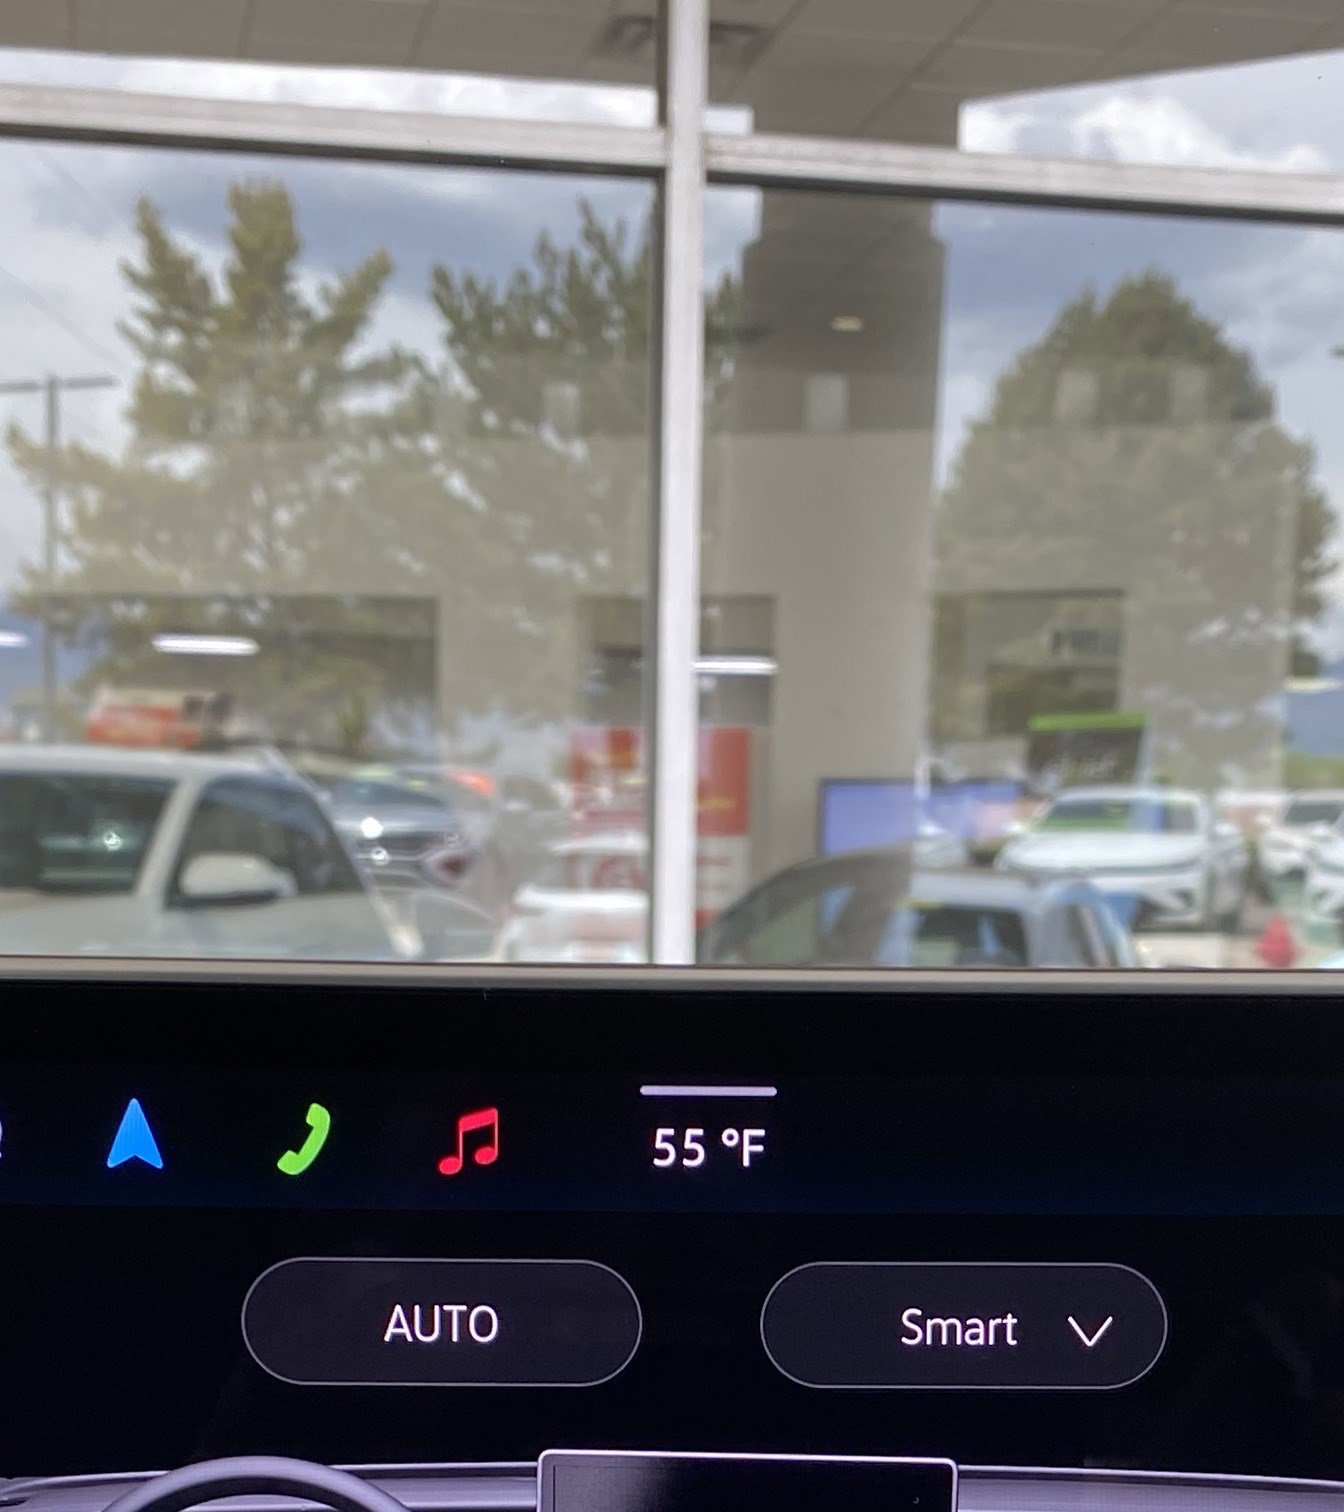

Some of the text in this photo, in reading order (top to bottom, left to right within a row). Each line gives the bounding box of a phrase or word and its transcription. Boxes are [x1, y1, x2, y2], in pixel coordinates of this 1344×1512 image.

[653, 1127, 766, 1168] 55 °F
[383, 1304, 499, 1344] AUTO
[901, 1307, 1018, 1346] Smart
